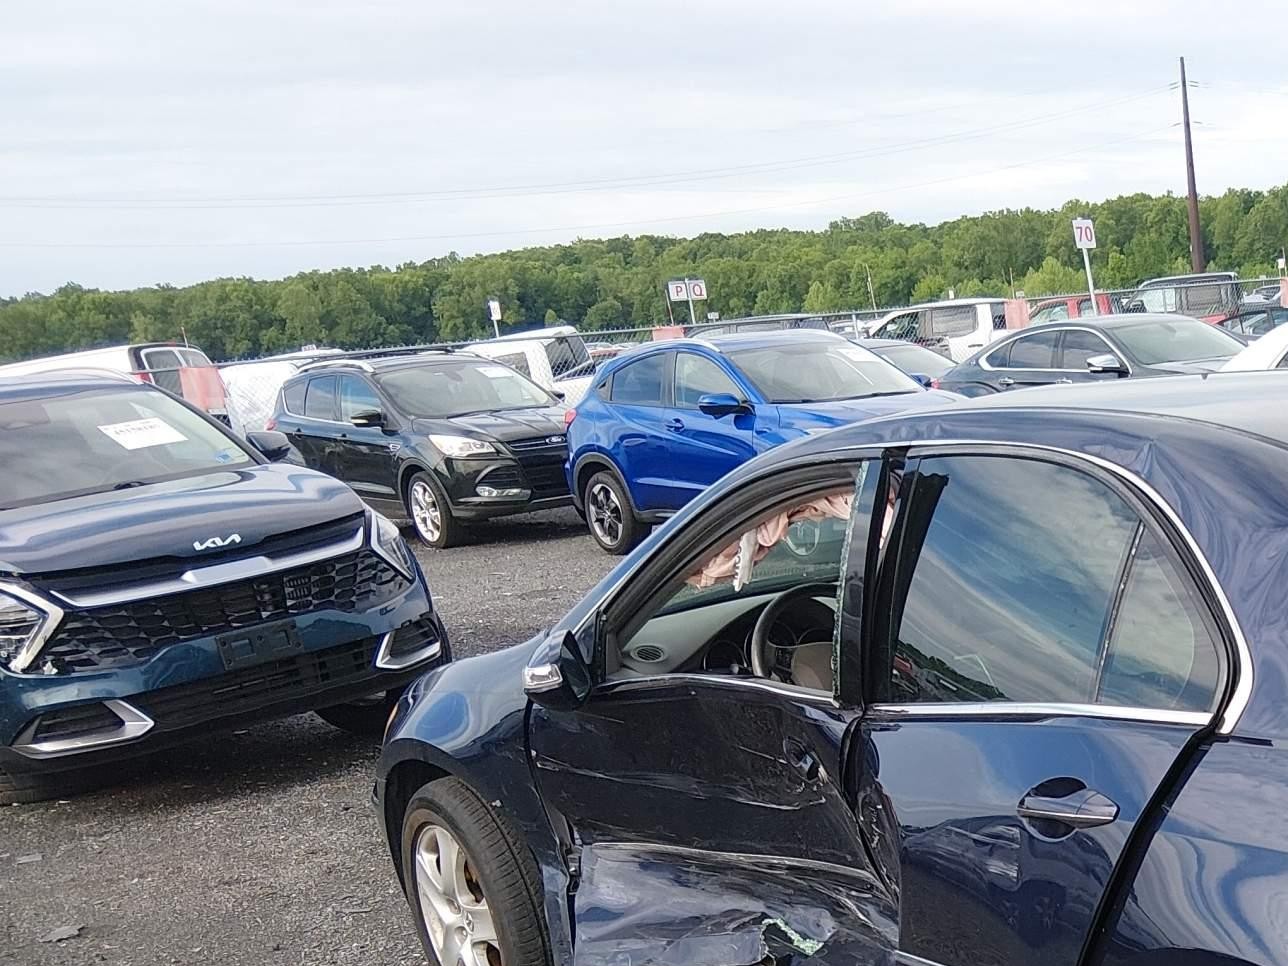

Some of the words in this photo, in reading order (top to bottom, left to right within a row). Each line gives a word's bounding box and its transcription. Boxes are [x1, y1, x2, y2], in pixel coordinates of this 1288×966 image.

[1075, 226, 1093, 242] 70
[675, 285, 683, 297] P
[692, 283, 705, 297] Q
